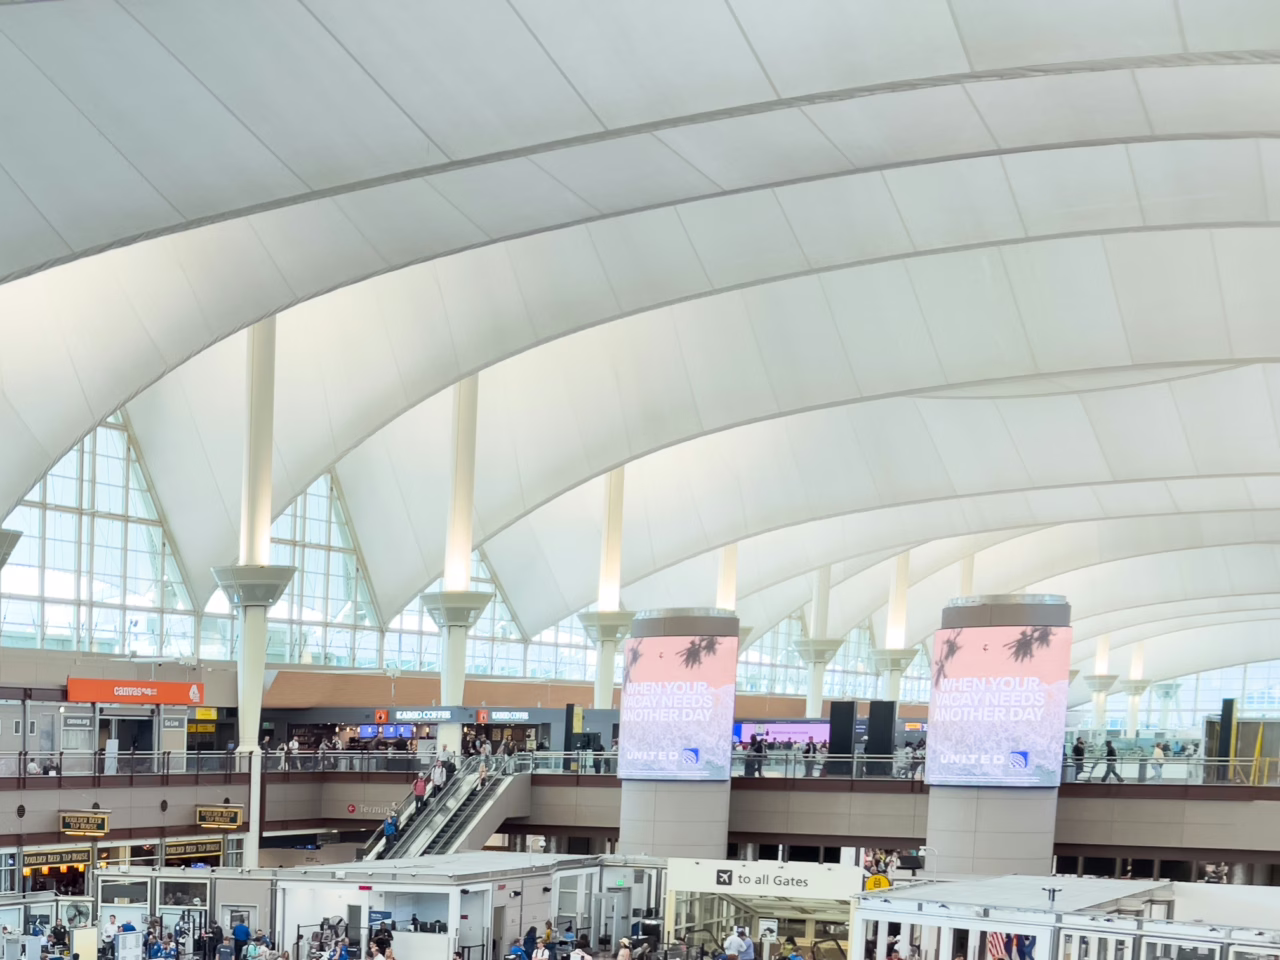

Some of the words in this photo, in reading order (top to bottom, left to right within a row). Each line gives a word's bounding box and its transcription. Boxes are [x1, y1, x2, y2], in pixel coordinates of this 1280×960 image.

[627, 682, 664, 695] WHEN
[664, 681, 708, 694] YOUR
[940, 678, 985, 691] WHEN
[990, 677, 1041, 691] YOUR
[114, 686, 142, 696] canvas
[661, 695, 712, 708] NEEDS
[935, 692, 982, 706] VACAY
[985, 692, 1045, 706] NEEDS
[423, 710, 452, 718] COFFEE
[622, 709, 678, 722] ANOTHER
[682, 709, 713, 722] DAY
[934, 708, 1006, 722] ANOTHER
[1010, 707, 1045, 721] DAY
[627, 752, 678, 760] UNITED
[940, 754, 1006, 764] UNITED
[738, 874, 752, 884] to
[754, 874, 770, 885] all
[774, 875, 809, 888] Gates
